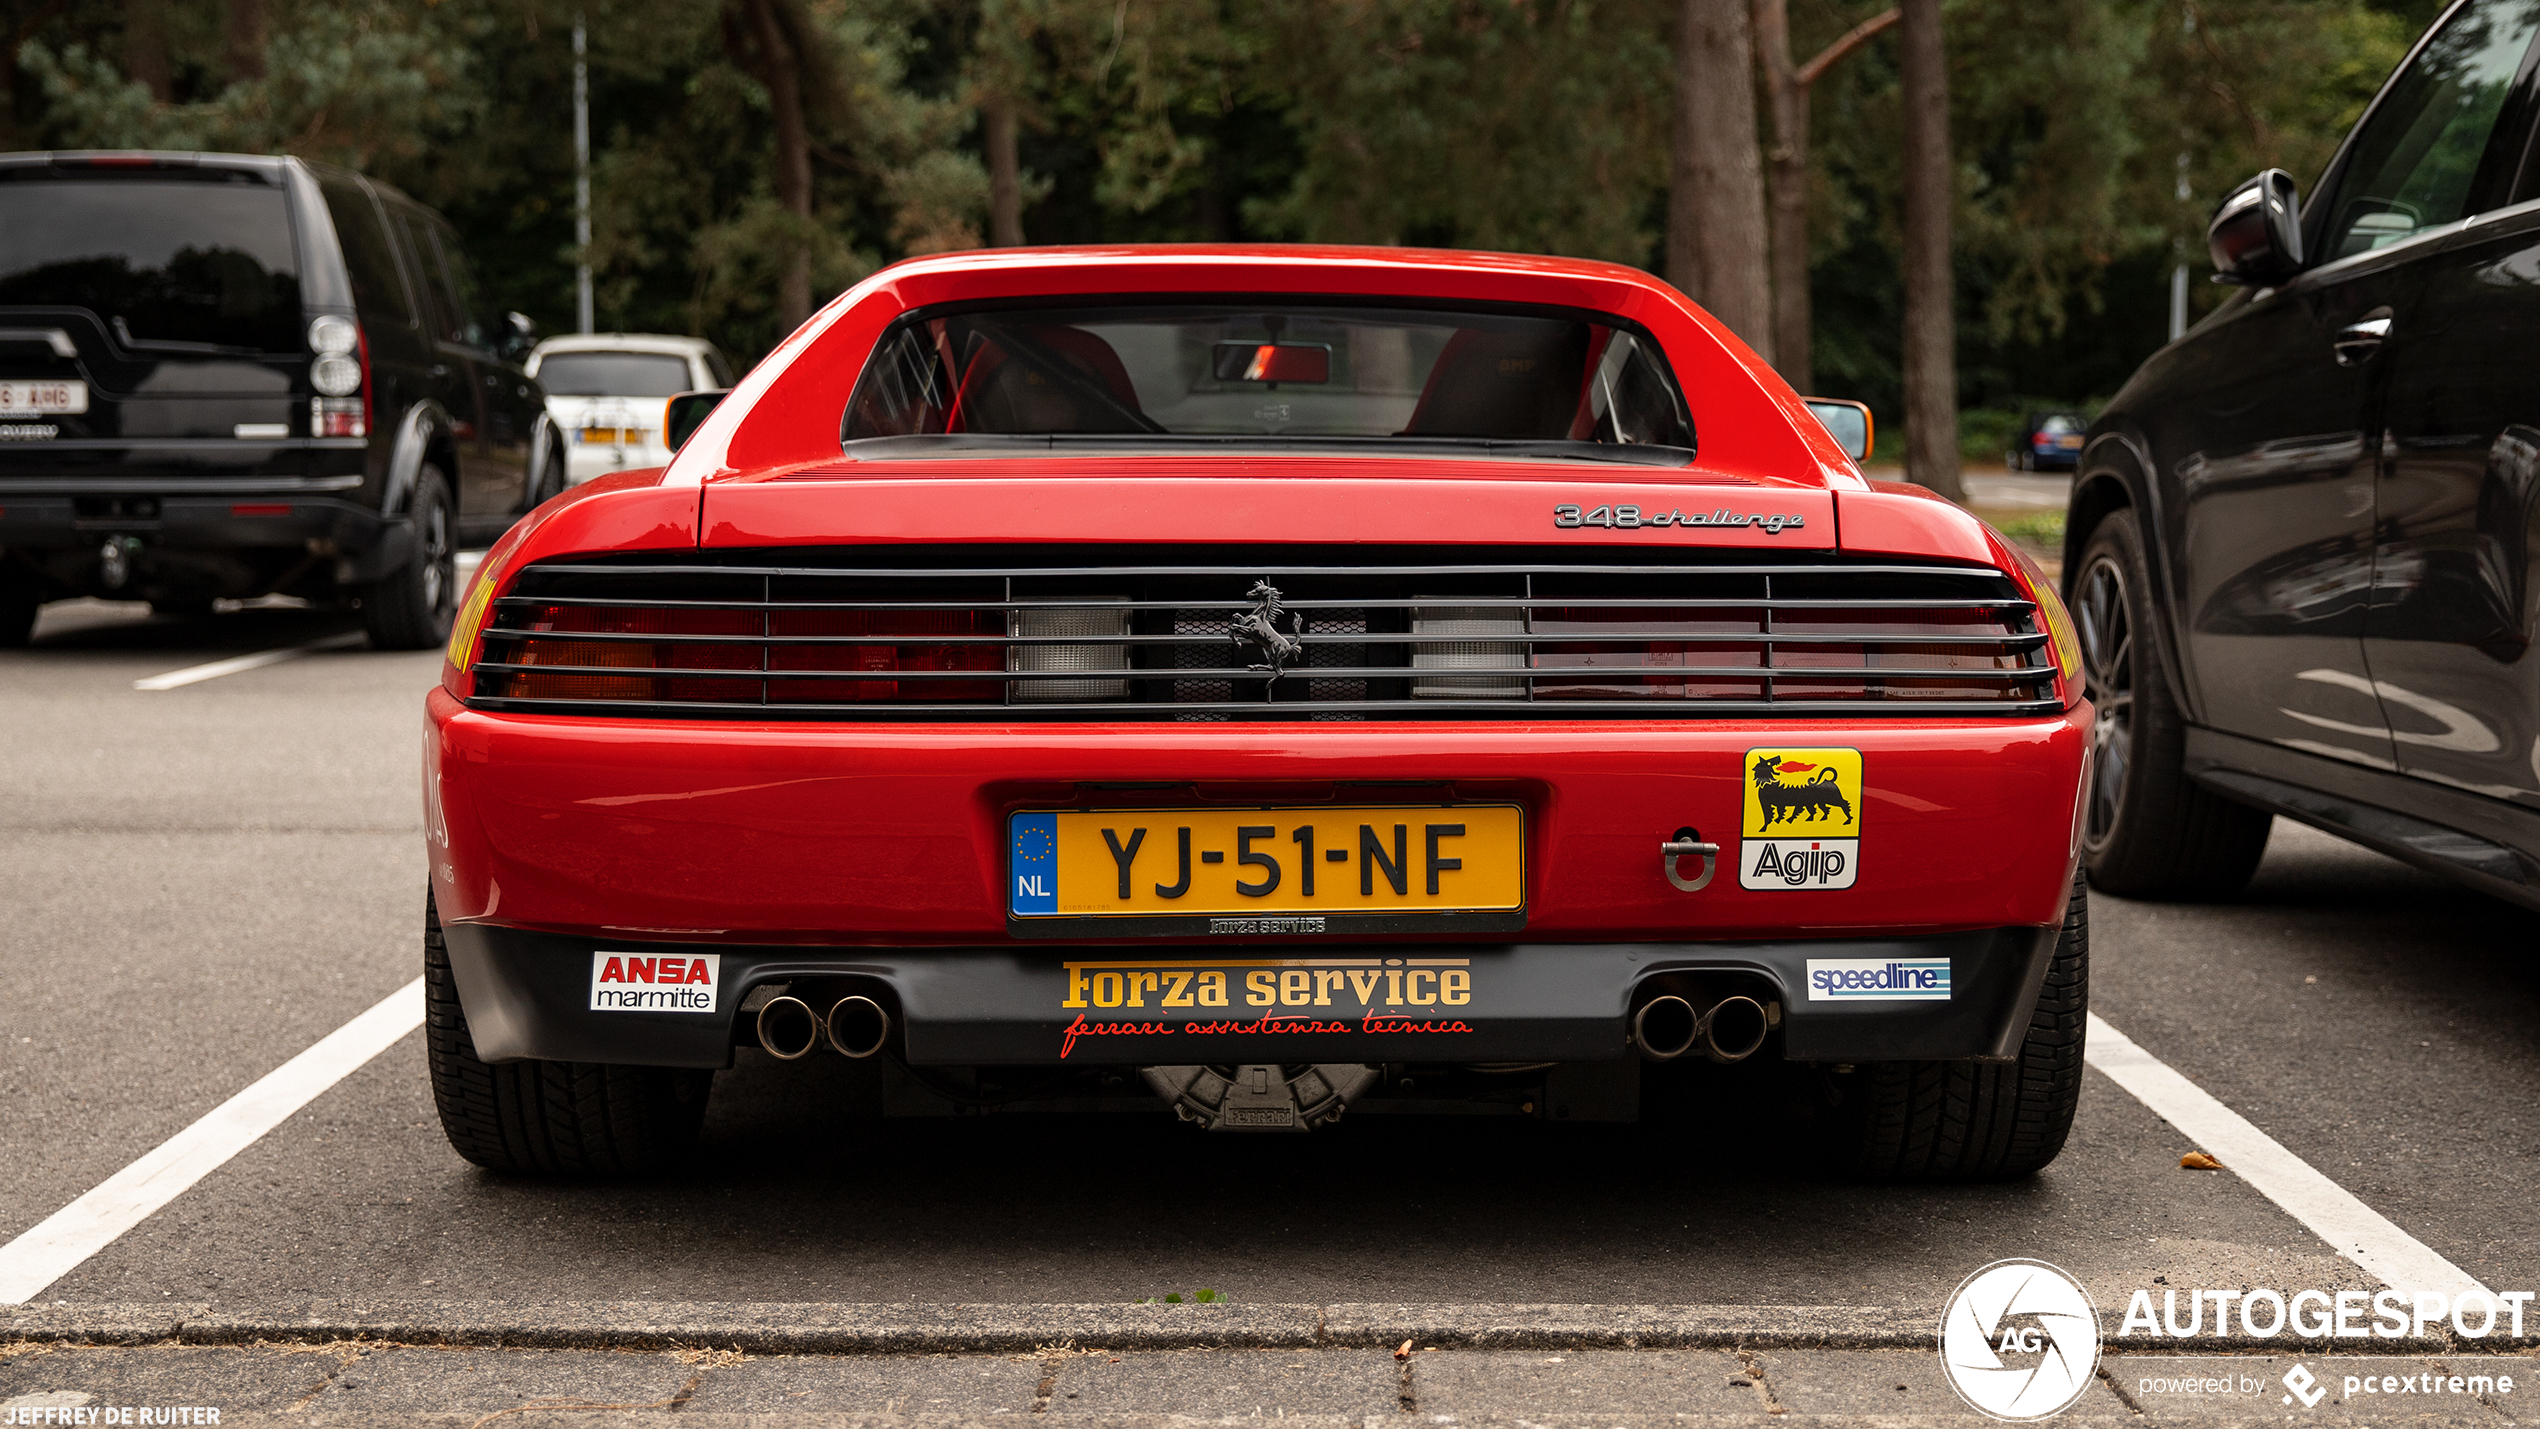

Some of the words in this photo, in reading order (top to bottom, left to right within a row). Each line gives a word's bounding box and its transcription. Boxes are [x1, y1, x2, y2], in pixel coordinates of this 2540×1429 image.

[1554, 504, 1643, 529] 348
[1650, 508, 1805, 535] challenge
[1101, 823, 1466, 899] YJ-51-NF
[1752, 842, 1846, 886] Agip
[1019, 875, 1051, 897] NL
[1259, 917, 1326, 934] service
[599, 956, 711, 985] ANSA
[1245, 958, 1471, 1007] service
[1812, 963, 1938, 996] speedline
[597, 987, 710, 1009] marmitte
[1061, 1010, 1175, 1059] ferrari
[1184, 1008, 1352, 1034] assistenza
